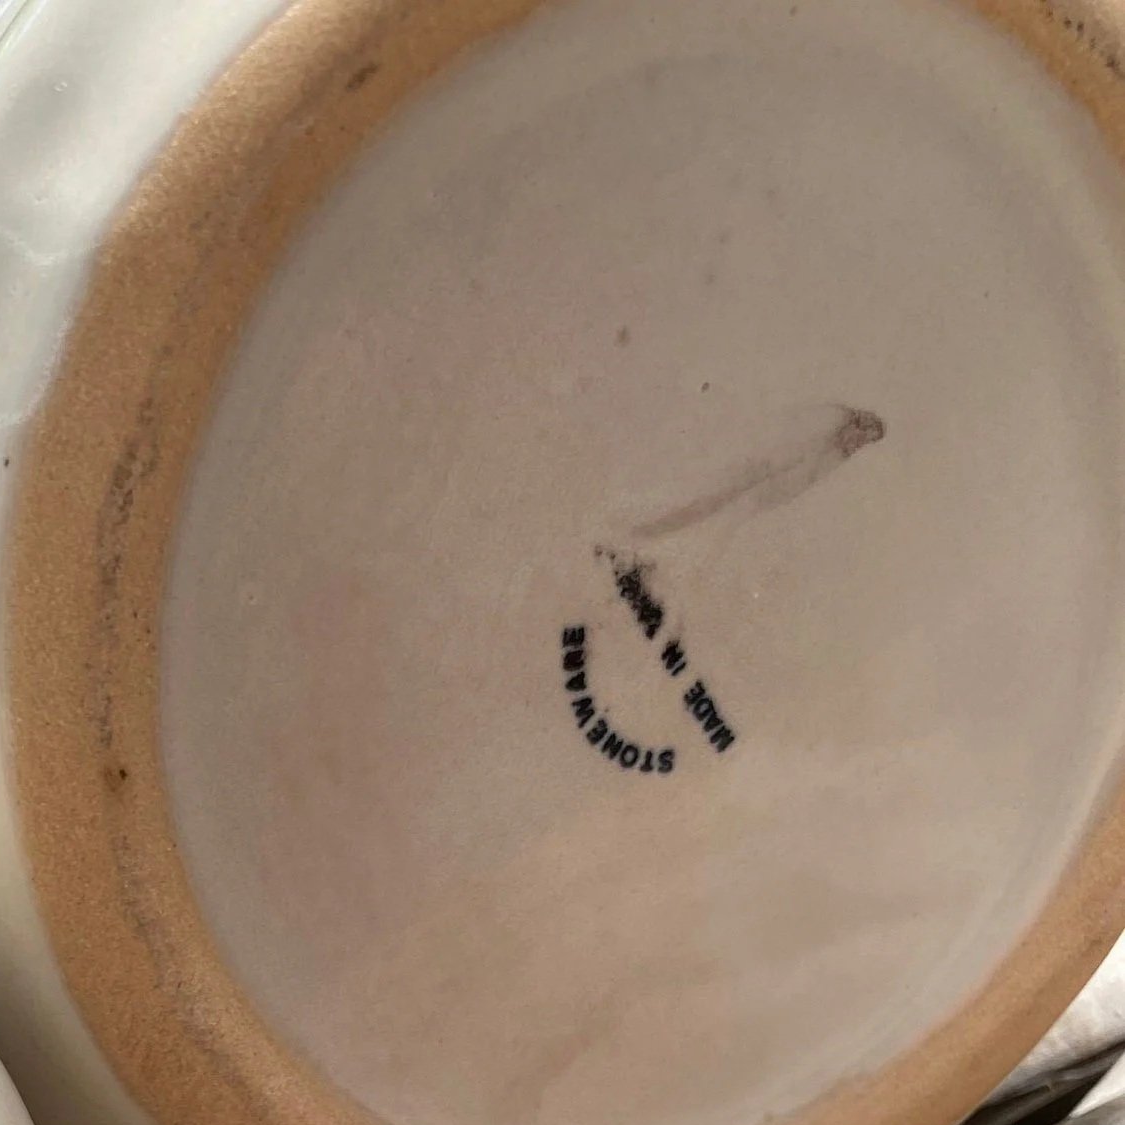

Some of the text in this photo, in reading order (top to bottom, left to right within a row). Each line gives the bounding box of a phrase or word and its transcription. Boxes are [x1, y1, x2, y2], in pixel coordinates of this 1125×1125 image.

[561, 625, 675, 773] STONEWARE
[661, 639, 736, 753] MADE IN
